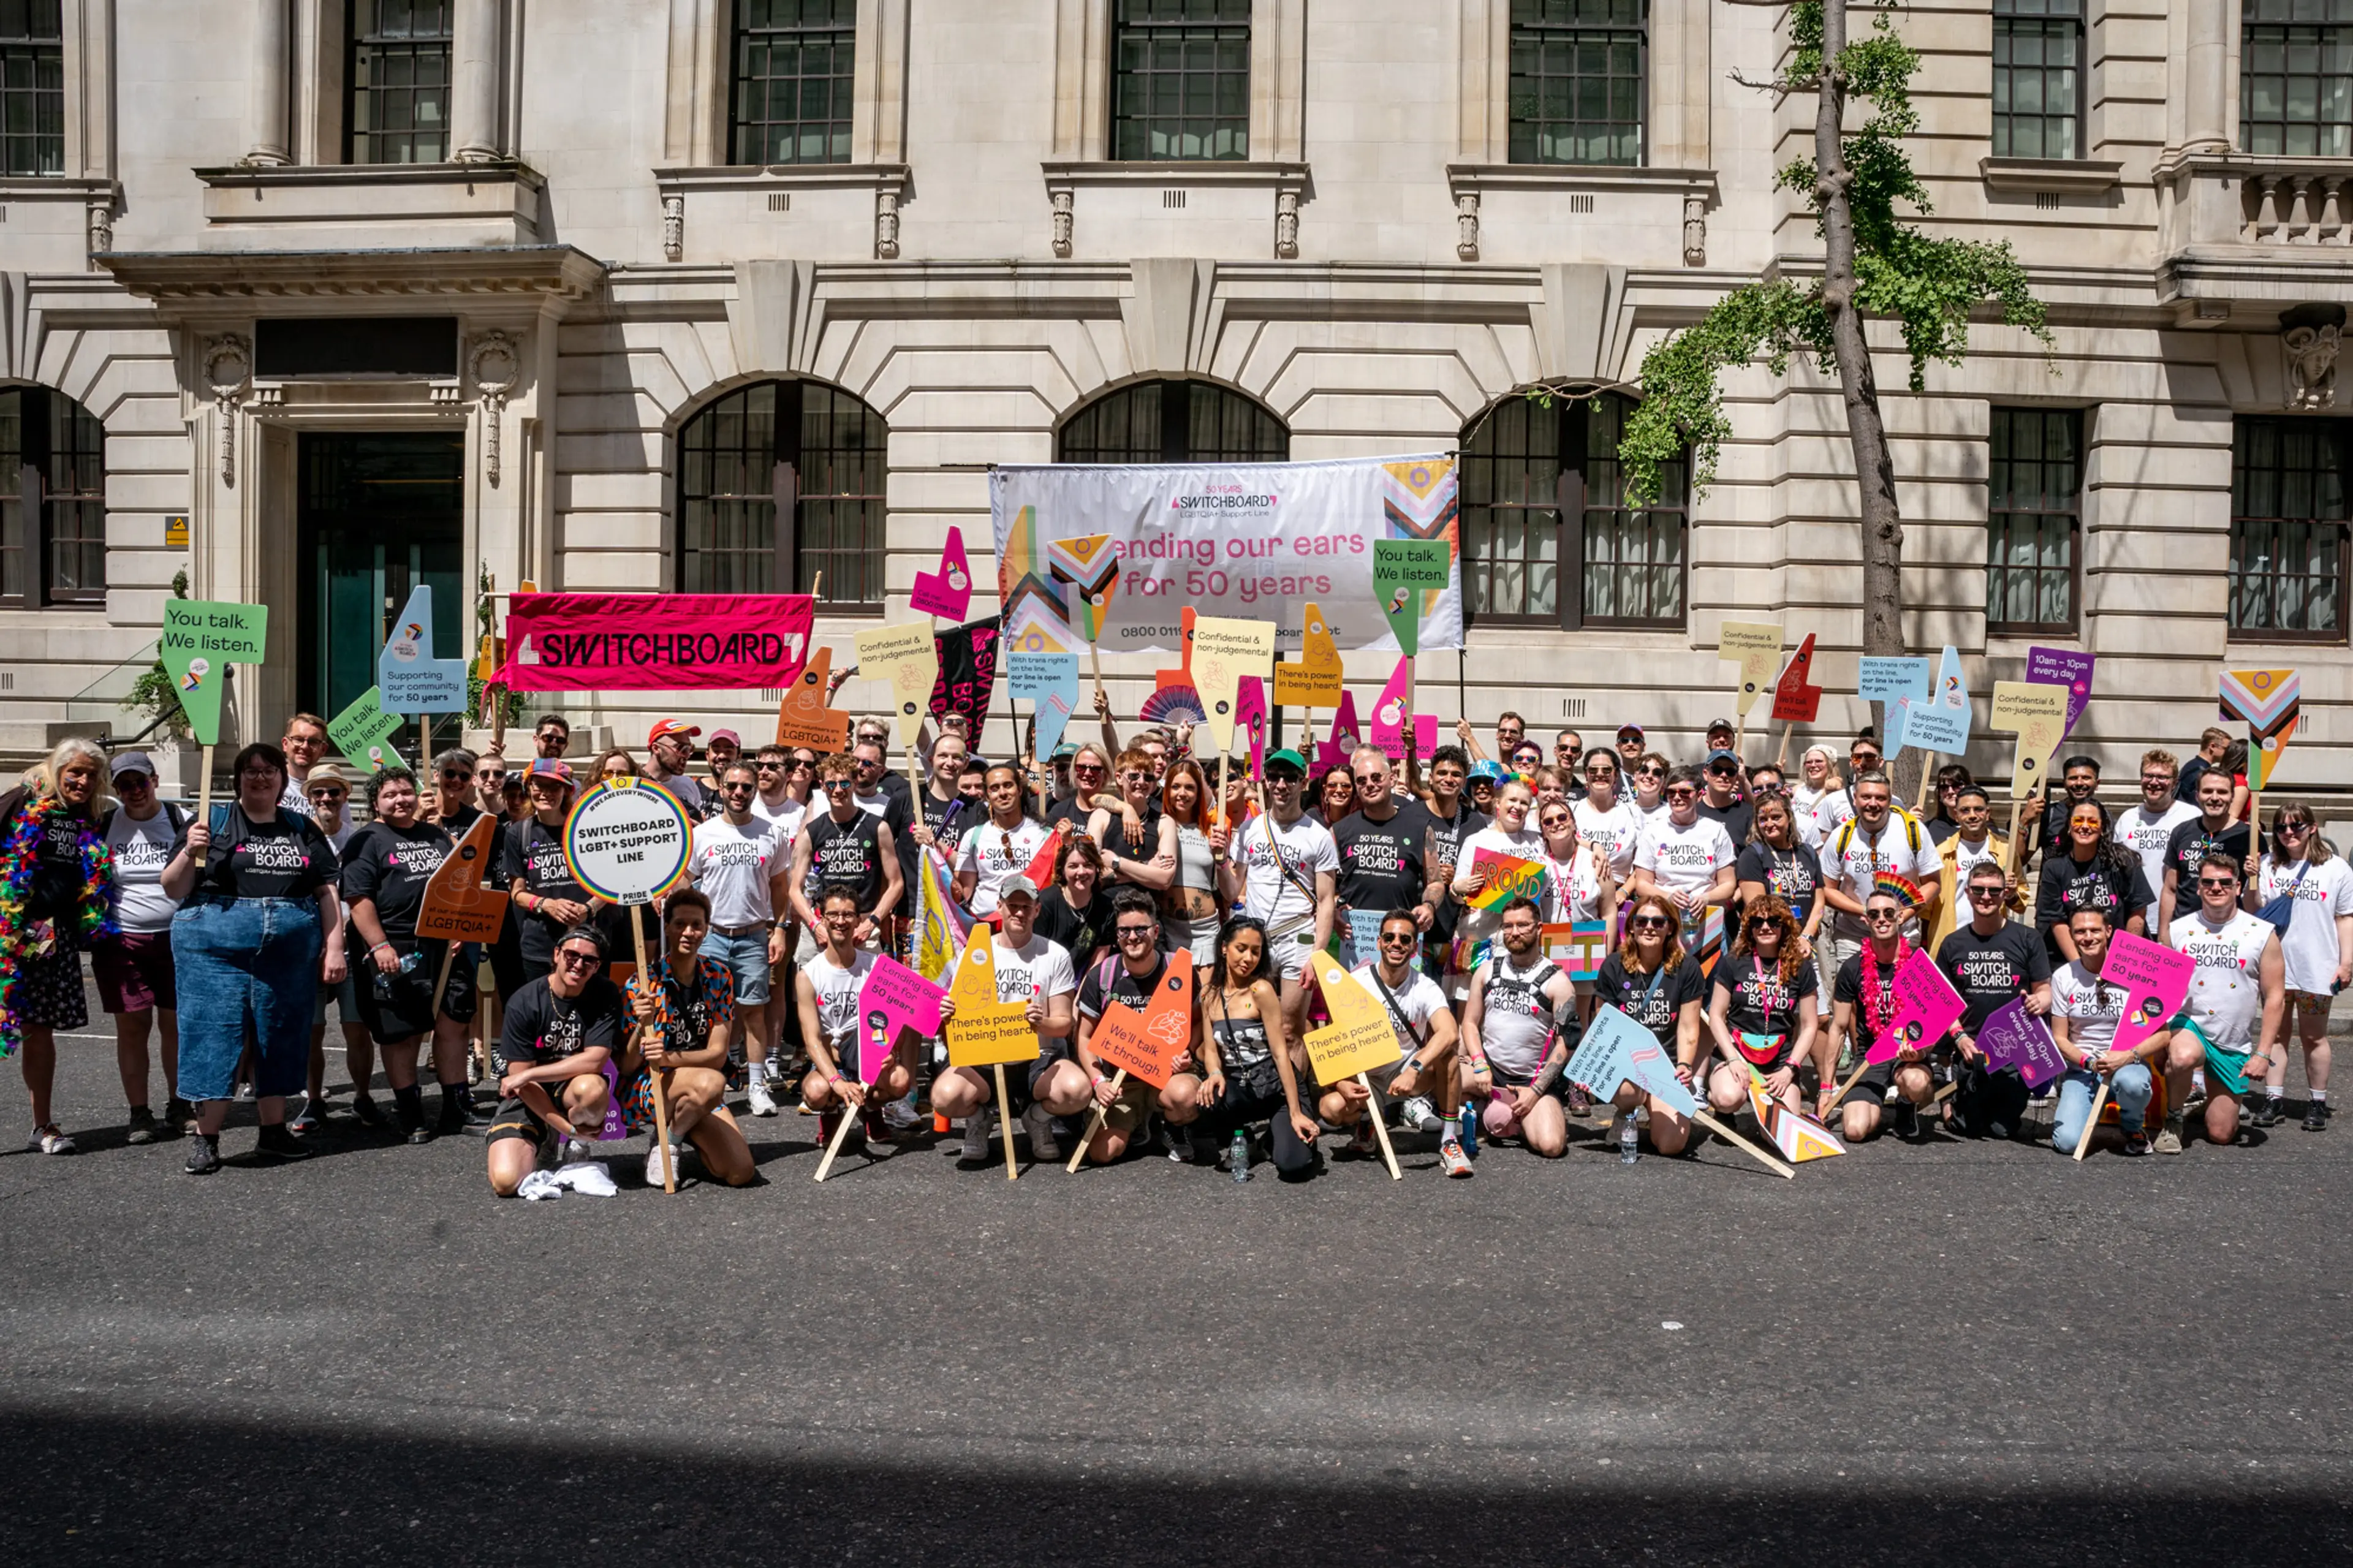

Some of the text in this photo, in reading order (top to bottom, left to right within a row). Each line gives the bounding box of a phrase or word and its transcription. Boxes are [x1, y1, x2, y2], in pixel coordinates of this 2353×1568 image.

[1206, 484, 1243, 494] 50 YEARS
[1180, 495, 1269, 509] SWITCHBOARD
[1115, 532, 1365, 567] ending our ears
[1377, 548, 1438, 562] You talk.
[1376, 567, 1446, 581] We listen.
[1124, 570, 1331, 603] for 50 years
[168, 609, 249, 629] You talk.
[1121, 627, 1156, 637] 0800
[1199, 631, 1260, 644] Confidential &
[1724, 631, 1763, 640] Confidential
[166, 632, 257, 653] We listen.
[542, 632, 784, 666] SWITCHBOARD
[860, 635, 921, 653] Confidential &
[1723, 640, 1778, 650] non-judgemental
[862, 645, 931, 662] non-judgemental
[1197, 643, 1269, 657] non-judgemental
[1050, 656, 1069, 665] rights
[2035, 654, 2088, 670] 10am 10pm
[387, 671, 442, 681] Supporting
[1278, 668, 1337, 682] There's power
[2033, 668, 2076, 681] every day
[407, 682, 460, 692] community
[1288, 680, 1312, 691] being
[1314, 681, 1341, 690] heard.
[388, 693, 404, 702] for
[422, 694, 449, 703] years
[1998, 694, 2047, 705] Confidential
[1996, 706, 2063, 716] non-judgemental
[331, 704, 379, 741] You talk.
[1913, 711, 1953, 727] Supporting
[343, 714, 396, 756] We listen.
[782, 730, 838, 745] LGBTQIA+
[1922, 731, 1953, 744] 50 years
[578, 819, 675, 839] SWITCHBOARD
[396, 841, 407, 850] 50
[579, 840, 618, 854] LGBT+
[620, 833, 678, 849] SUPPORT
[825, 839, 836, 848] 50
[1370, 835, 1394, 844] YEARS
[116, 841, 169, 855] SWITCH
[246, 843, 300, 855] SWITCH
[714, 842, 759, 856] SWITCH
[1353, 844, 1398, 857] SWITCH
[1664, 844, 1704, 855] SWITCH
[255, 854, 303, 868] BOARD
[397, 848, 442, 864] SWITCH
[616, 852, 644, 863] LINE
[721, 856, 760, 867] BOARD
[821, 849, 863, 863] SWITCH
[1358, 855, 1398, 870] BOARD
[1670, 855, 1707, 866] BOARD
[828, 861, 864, 873] BOARD
[1473, 860, 1541, 900] PROUD
[426, 915, 493, 933] LGBTQIA+
[1573, 935, 1604, 973] T
[1968, 951, 2004, 960] 50 YEARS
[2119, 939, 2183, 969] Lending our
[2189, 942, 2237, 956] SWITCH
[1963, 962, 2010, 974] SWITCH
[2115, 953, 2159, 973] ears for
[2196, 955, 2238, 969] BOARD
[1908, 969, 1922, 988] ears
[1971, 975, 2012, 987] BOARD
[2110, 963, 2158, 987] 50 years
[876, 975, 918, 1001] ears for
[882, 963, 941, 1002] Lending our
[1915, 958, 1953, 1007] Lending our
[871, 983, 915, 1015] 50 years
[1120, 995, 1131, 1005] 50
[1900, 976, 1911, 991] 50
[1907, 990, 1928, 1015] years
[1494, 998, 1531, 1016] BOARD
[950, 1015, 991, 1029] There's
[953, 1025, 1038, 1042] in being heard.
[1110, 1023, 1159, 1058] We'll talk
[1309, 1019, 1384, 1051] There's power
[2009, 1011, 2039, 1061] every day
[1316, 1031, 1393, 1062] in being heard.
[1101, 1038, 1162, 1078] it through.
[2036, 1041, 2055, 1068] 10pm
[1569, 1058, 1585, 1076] With
